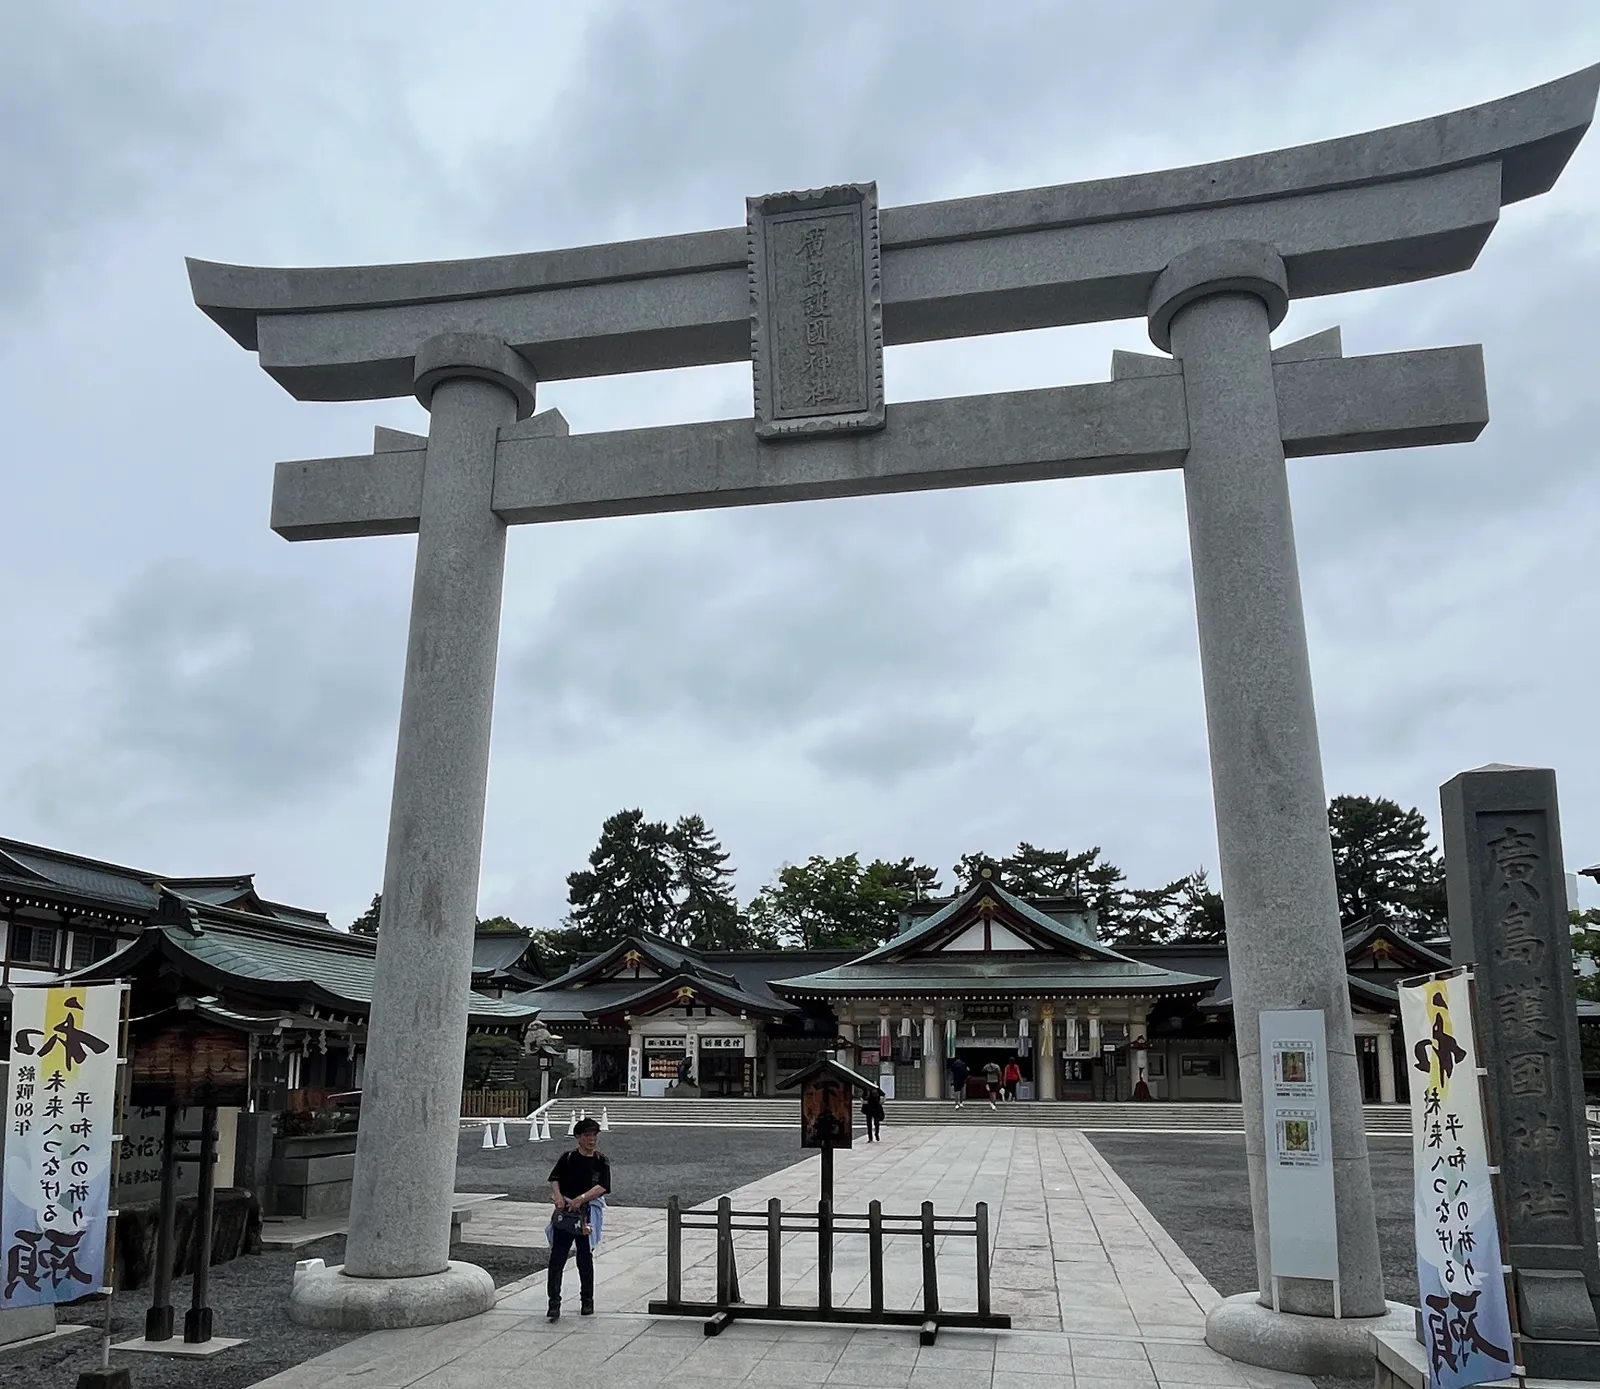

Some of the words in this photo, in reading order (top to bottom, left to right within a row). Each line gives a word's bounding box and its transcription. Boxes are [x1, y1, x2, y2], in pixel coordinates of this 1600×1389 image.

[1485, 827, 1570, 1221] 廣島護國神社
